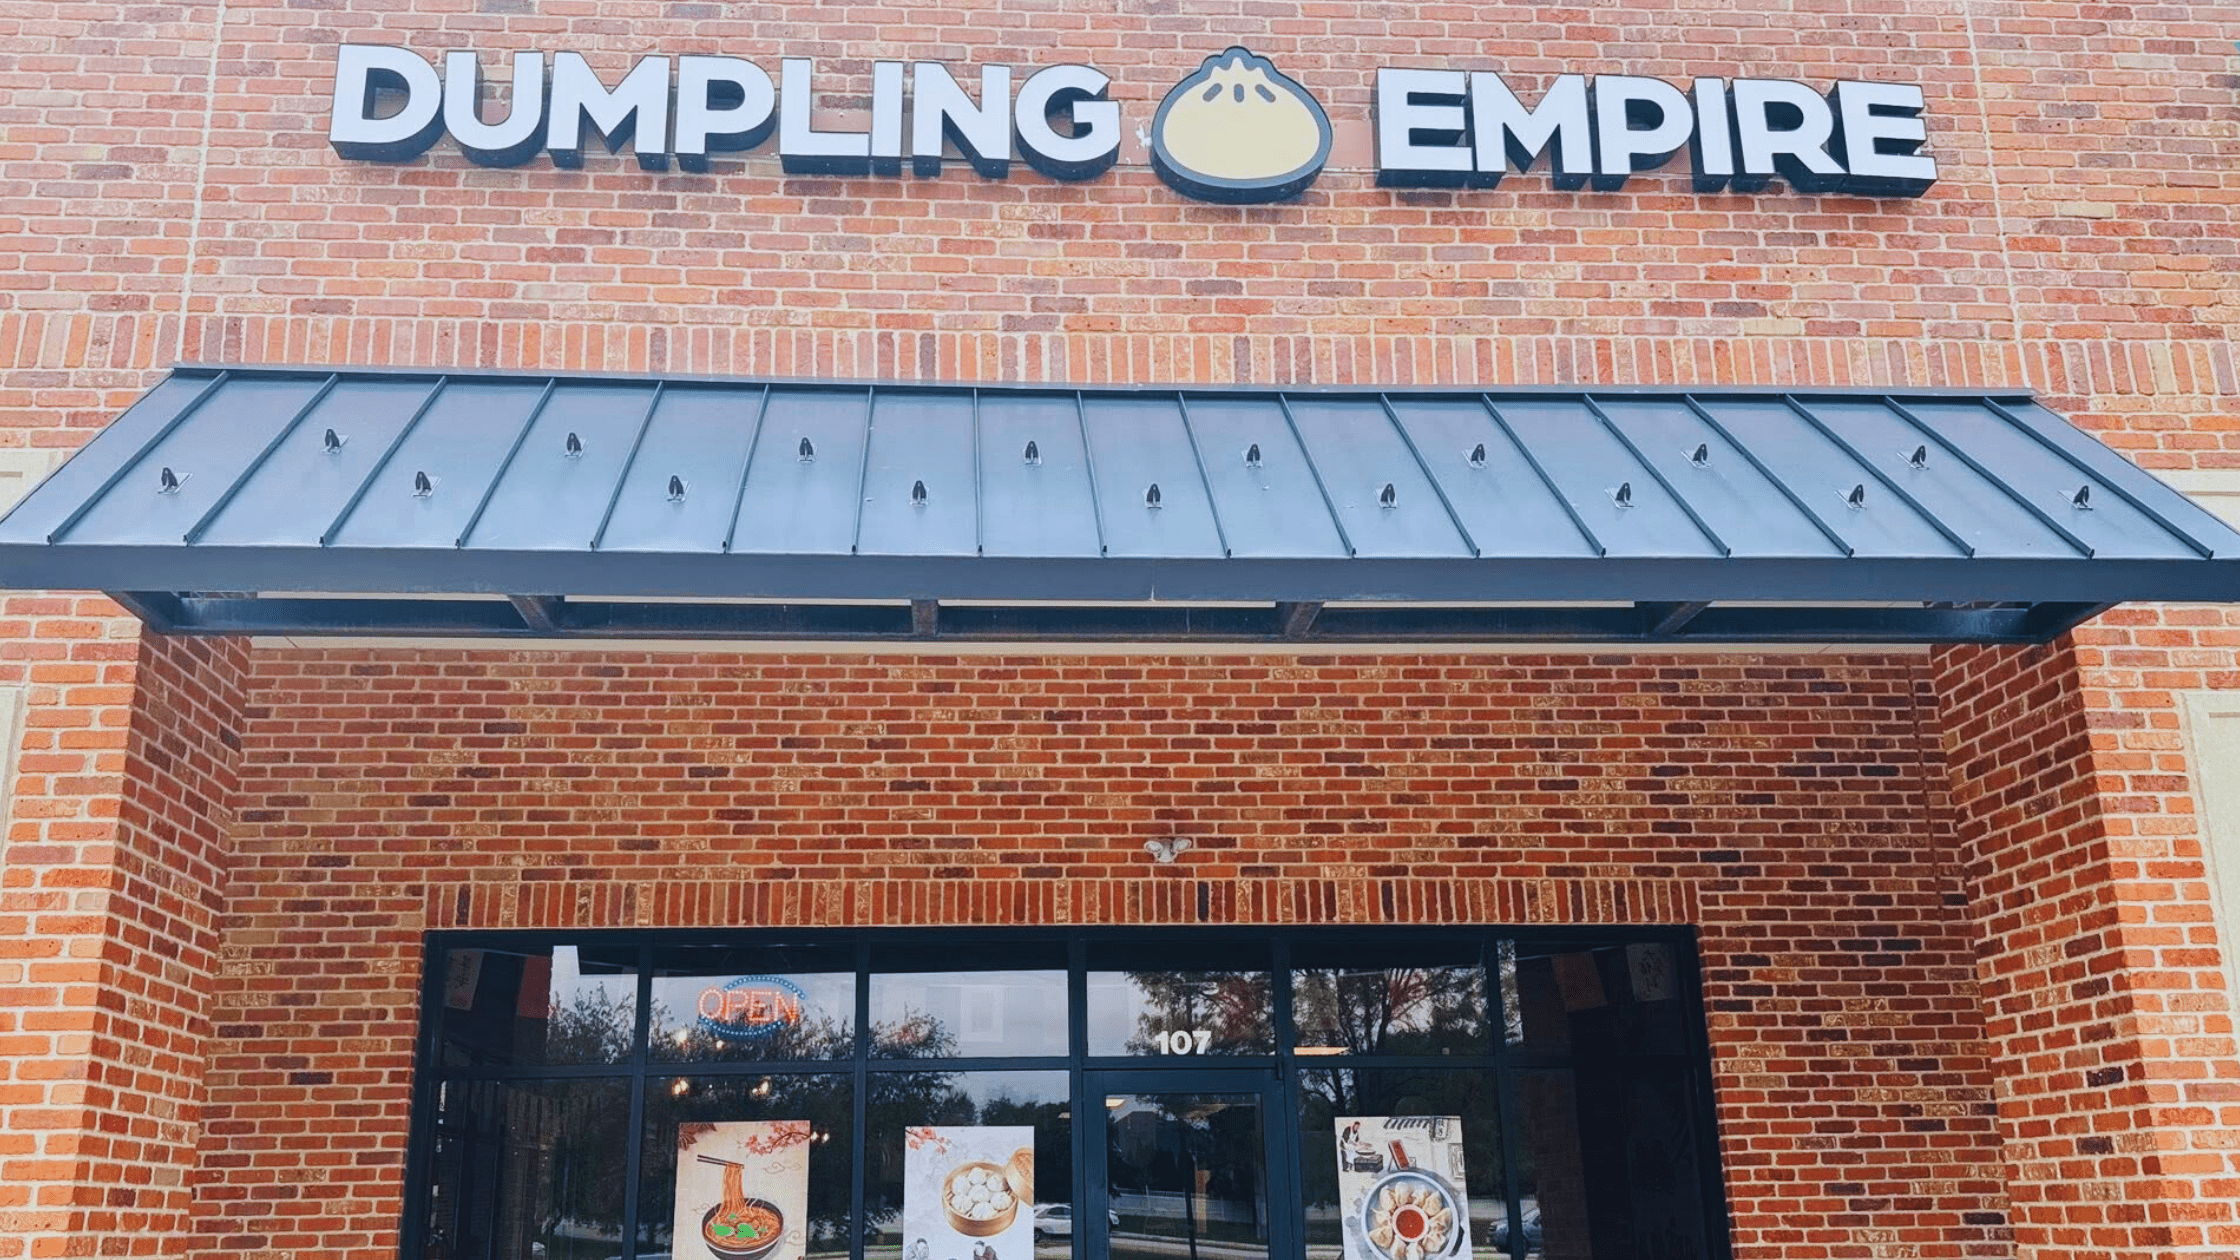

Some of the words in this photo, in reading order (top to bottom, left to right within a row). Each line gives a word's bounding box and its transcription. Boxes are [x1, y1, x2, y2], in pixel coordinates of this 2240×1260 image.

[329, 43, 1122, 181] DUMPLING
[1375, 66, 1938, 198] EMPIRE
[698, 986, 799, 1026] OPEN
[1155, 1030, 1212, 1055] 107
